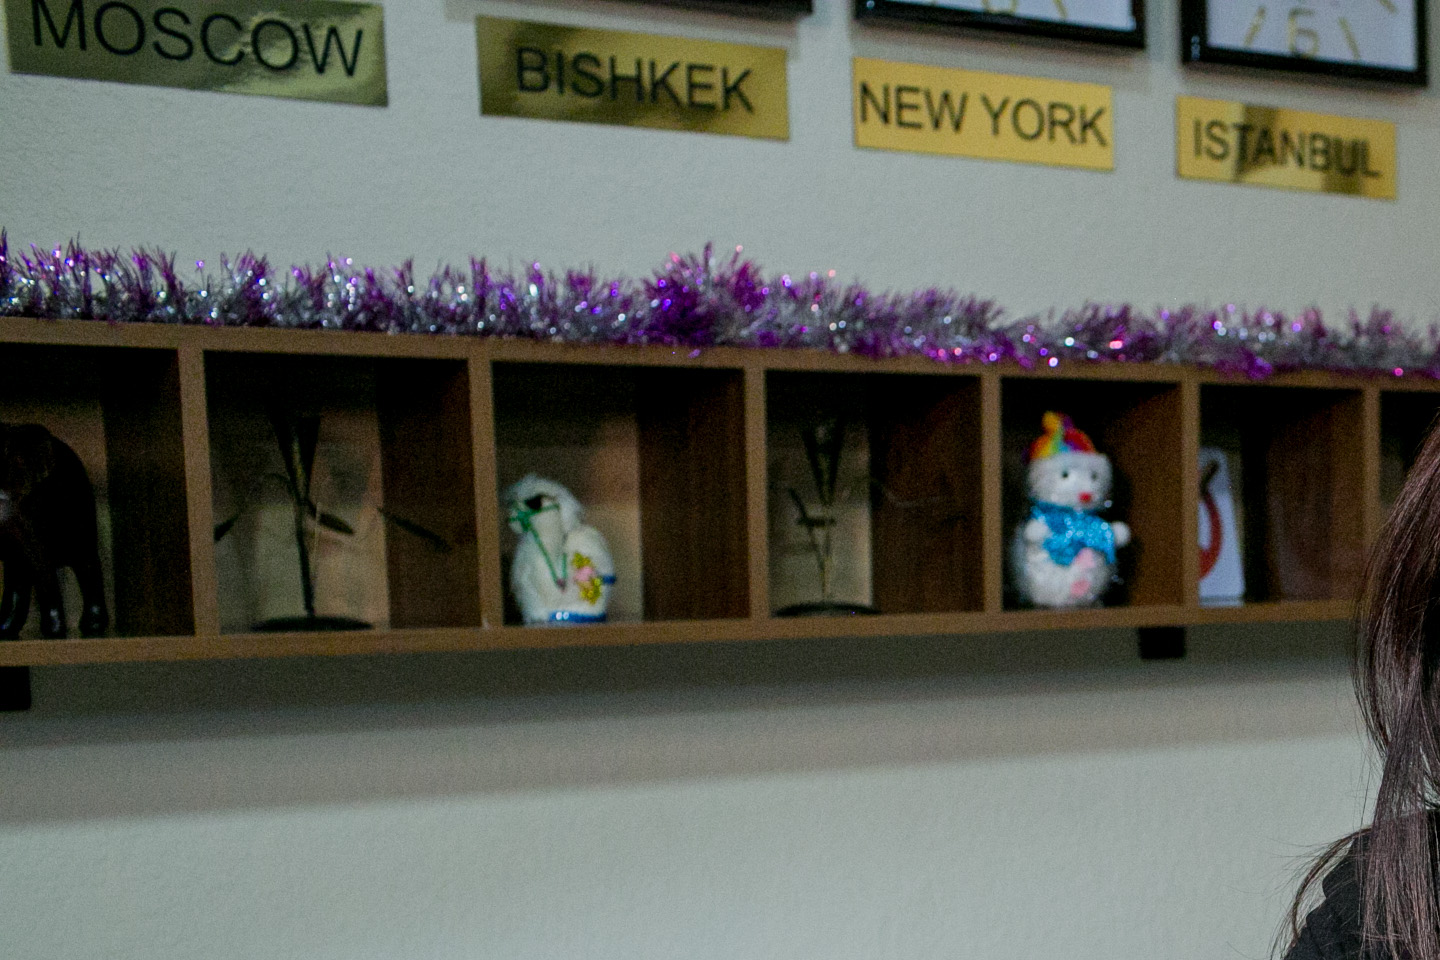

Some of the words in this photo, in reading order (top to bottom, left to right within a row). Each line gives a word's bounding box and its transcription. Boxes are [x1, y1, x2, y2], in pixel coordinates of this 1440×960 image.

[30, 0, 363, 77] MOSCOW
[516, 47, 754, 112] BISHKEK
[859, 82, 969, 132] NEW
[980, 95, 1108, 147] YORK
[1193, 118, 1381, 177] ISTANBUL
